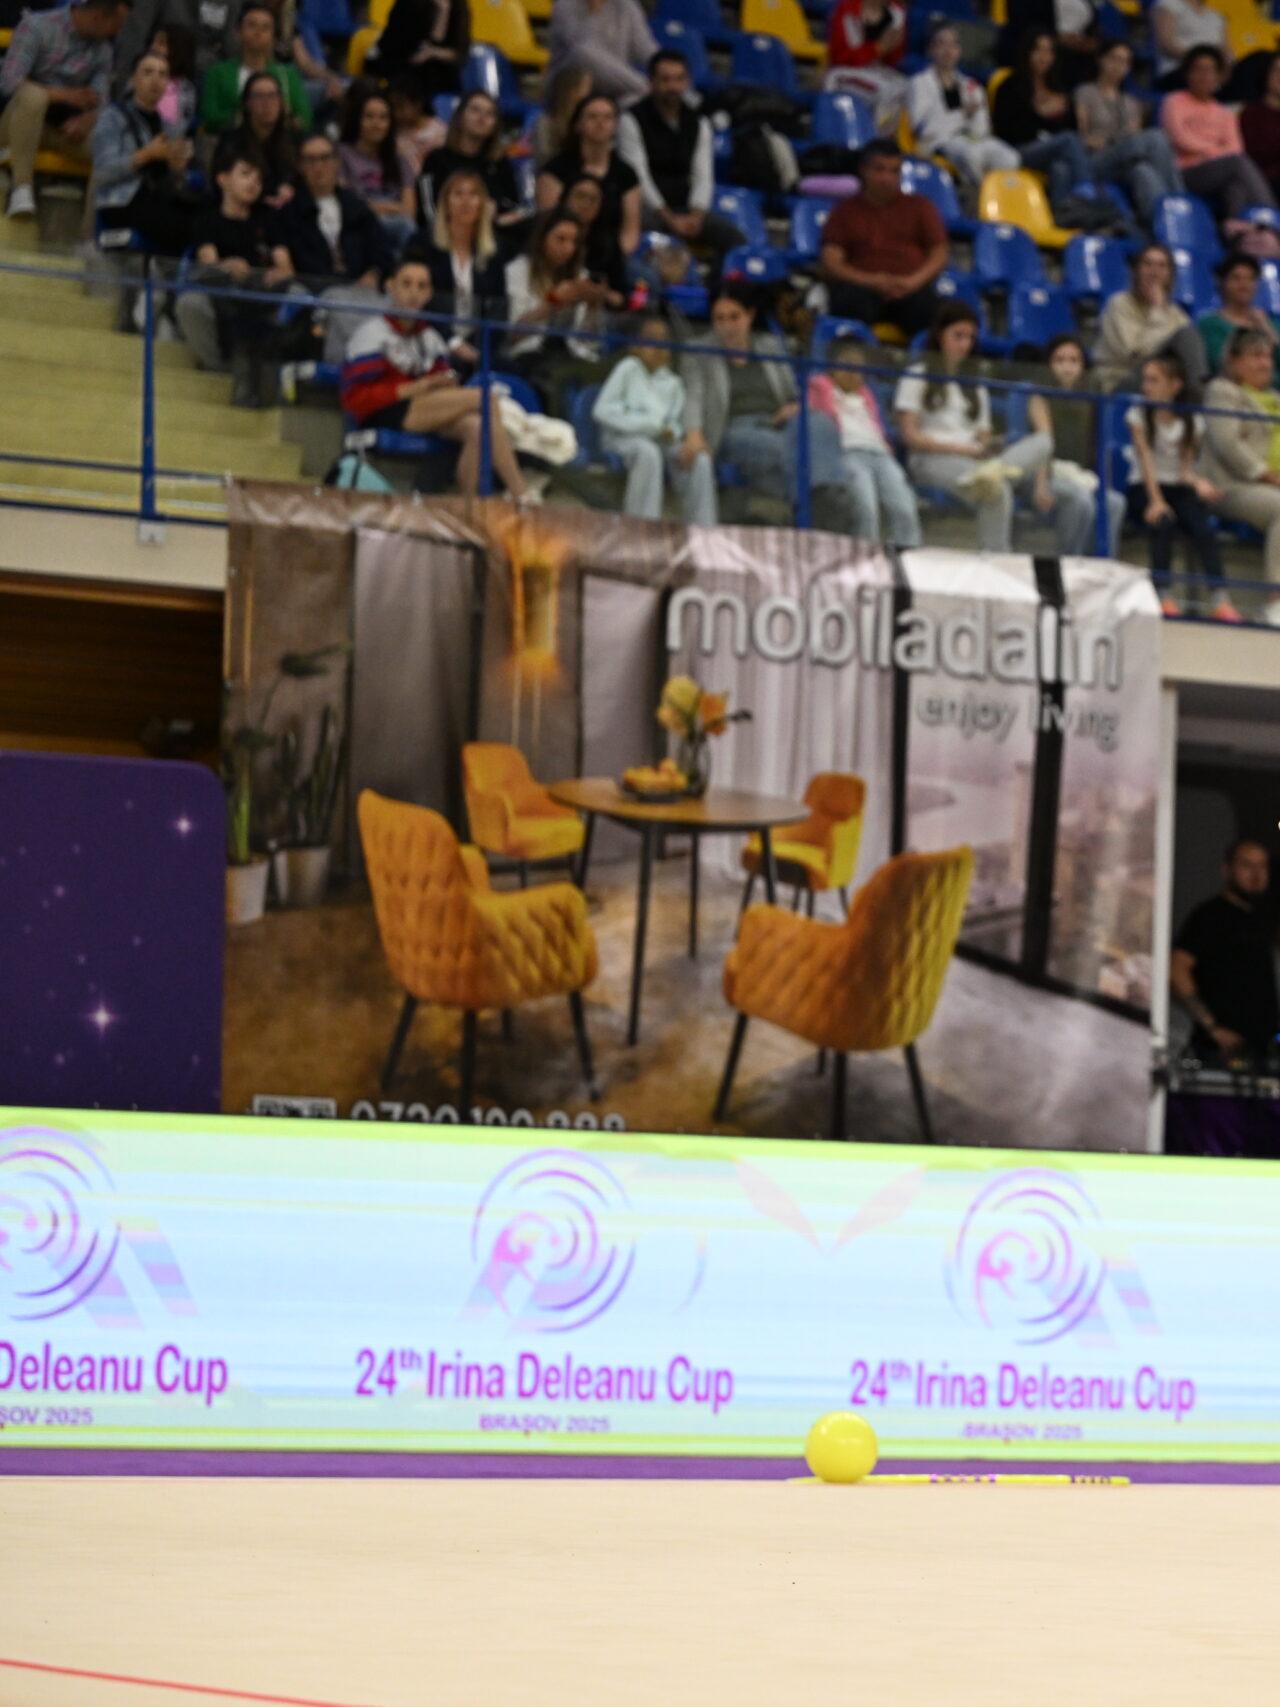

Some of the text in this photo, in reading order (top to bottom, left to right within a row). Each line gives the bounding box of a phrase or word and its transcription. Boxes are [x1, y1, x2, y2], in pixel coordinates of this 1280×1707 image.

[666, 584, 1121, 690] mobiladalin
[916, 693, 1019, 744] enjoy
[0, 1341, 228, 1407] Deleanu Cup
[355, 1347, 733, 1415] 24th Irina Deleanu Cup
[850, 1359, 1195, 1423] 24th Irina Deleanu Cup
[45, 1406, 93, 1426] 2025
[566, 1416, 611, 1432] 2025
